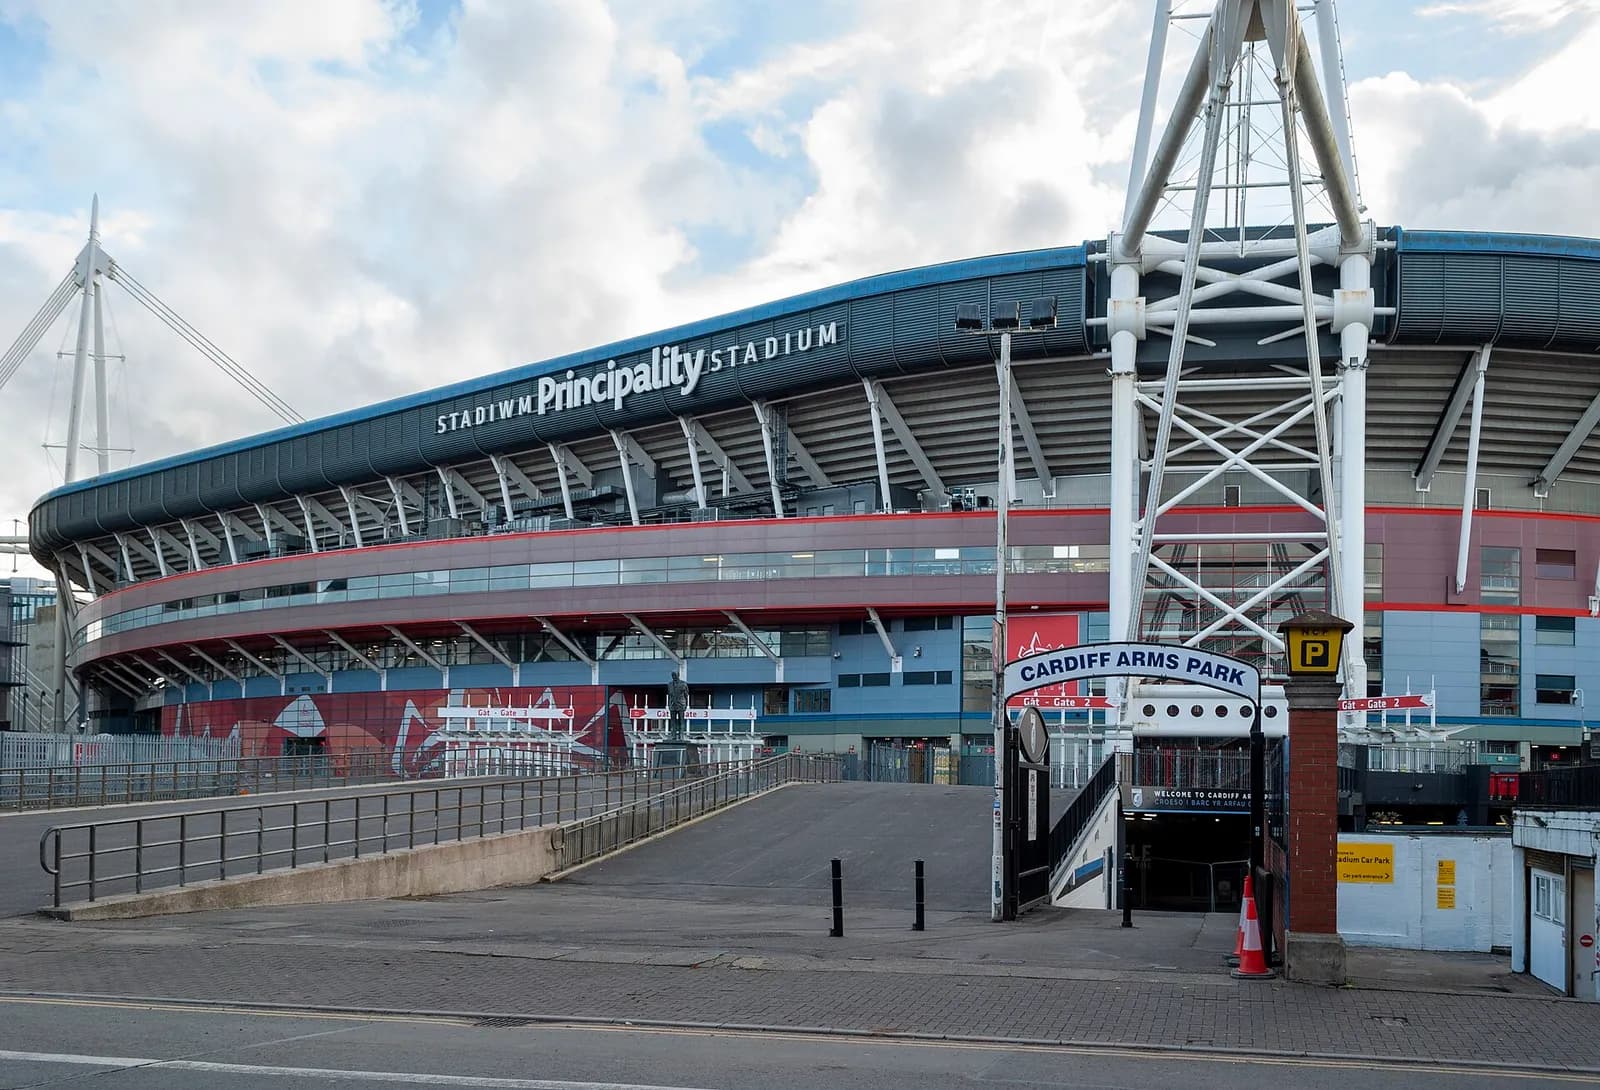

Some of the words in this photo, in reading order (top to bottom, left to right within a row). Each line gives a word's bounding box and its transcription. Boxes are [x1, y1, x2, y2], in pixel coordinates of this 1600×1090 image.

[436, 396, 532, 435] STADIWM
[537, 345, 706, 415] Principality
[712, 322, 838, 371] STADIUM
[1306, 643, 1324, 664] P
[1020, 652, 1111, 681] CARDIFF
[1117, 651, 1179, 669] ARMS
[1186, 658, 1246, 686] PARK
[1053, 698, 1075, 706] Gate
[1084, 698, 1090, 706] 2
[1367, 700, 1386, 708] Gate
[1394, 698, 1399, 706] 2
